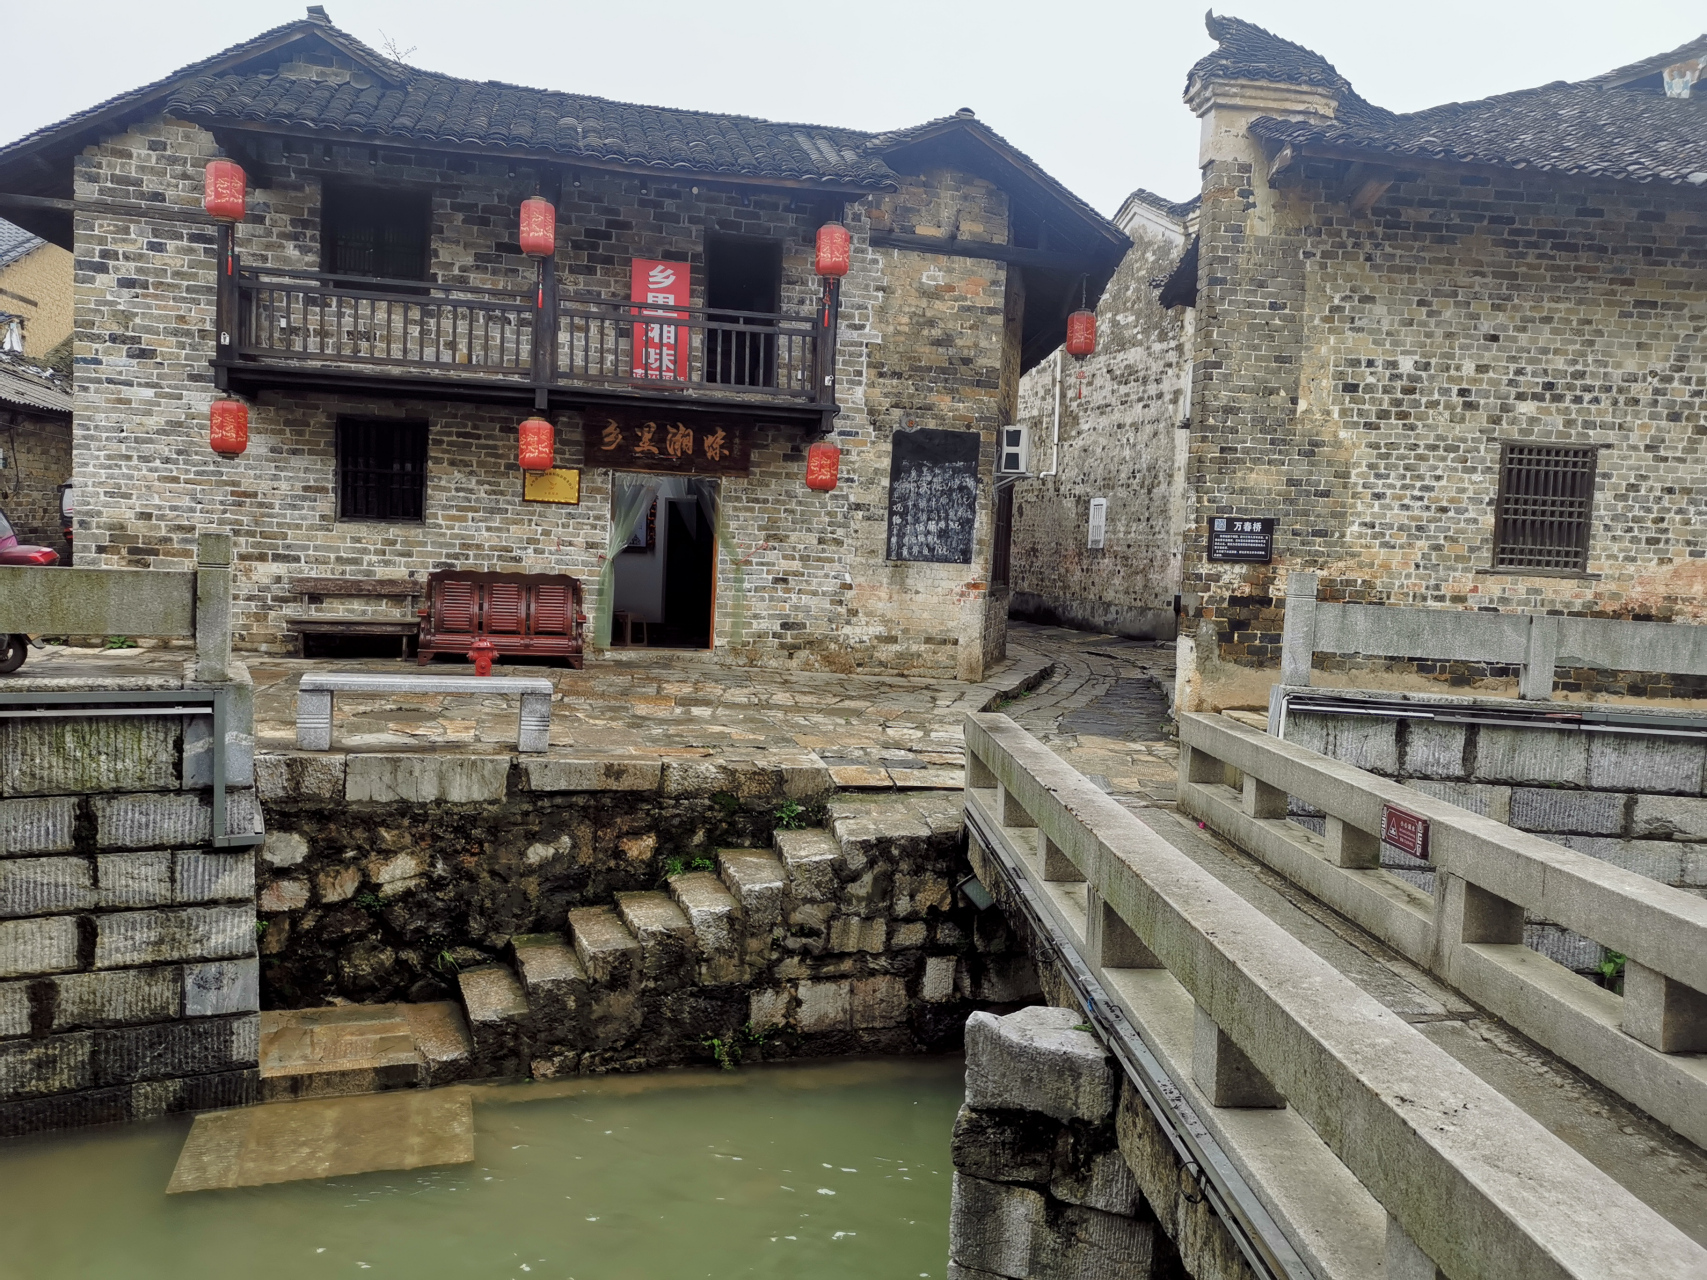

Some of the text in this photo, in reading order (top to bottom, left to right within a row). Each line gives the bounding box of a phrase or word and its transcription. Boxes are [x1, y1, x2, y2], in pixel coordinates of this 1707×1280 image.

[642, 265, 678, 371] 乡里湘味
[601, 418, 730, 462] 乡里湘味
[1233, 521, 1262, 532] 万春桥
